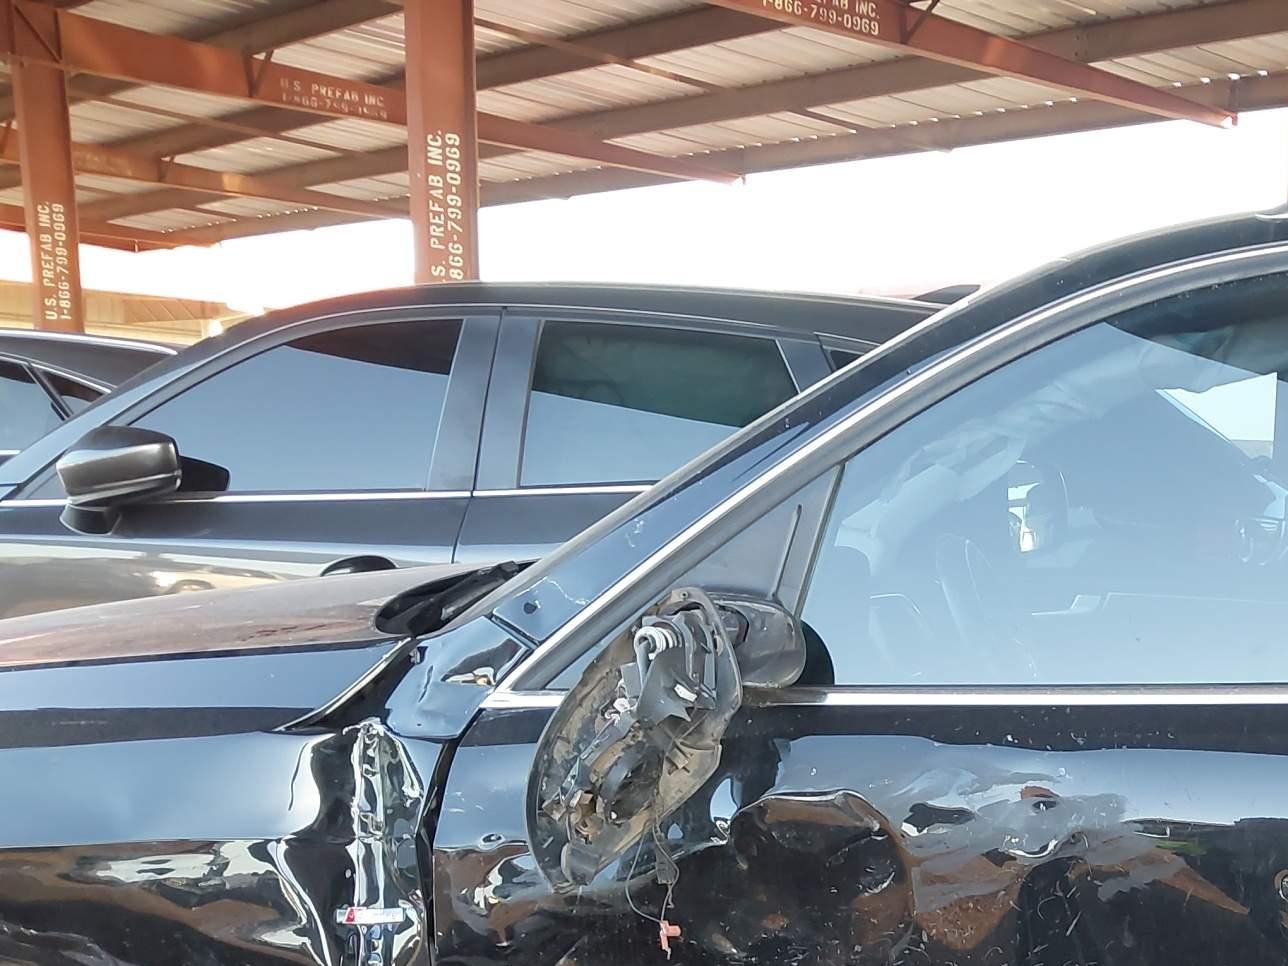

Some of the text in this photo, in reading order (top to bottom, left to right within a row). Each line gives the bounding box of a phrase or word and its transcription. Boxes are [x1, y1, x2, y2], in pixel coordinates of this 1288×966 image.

[427, 130, 443, 166] INC.
[445, 132, 464, 281] 866-799-0969
[37, 201, 58, 320] U.S. PREFAB INC.
[51, 202, 72, 320] 1-866-799-0969
[428, 174, 446, 250] PREFAB
